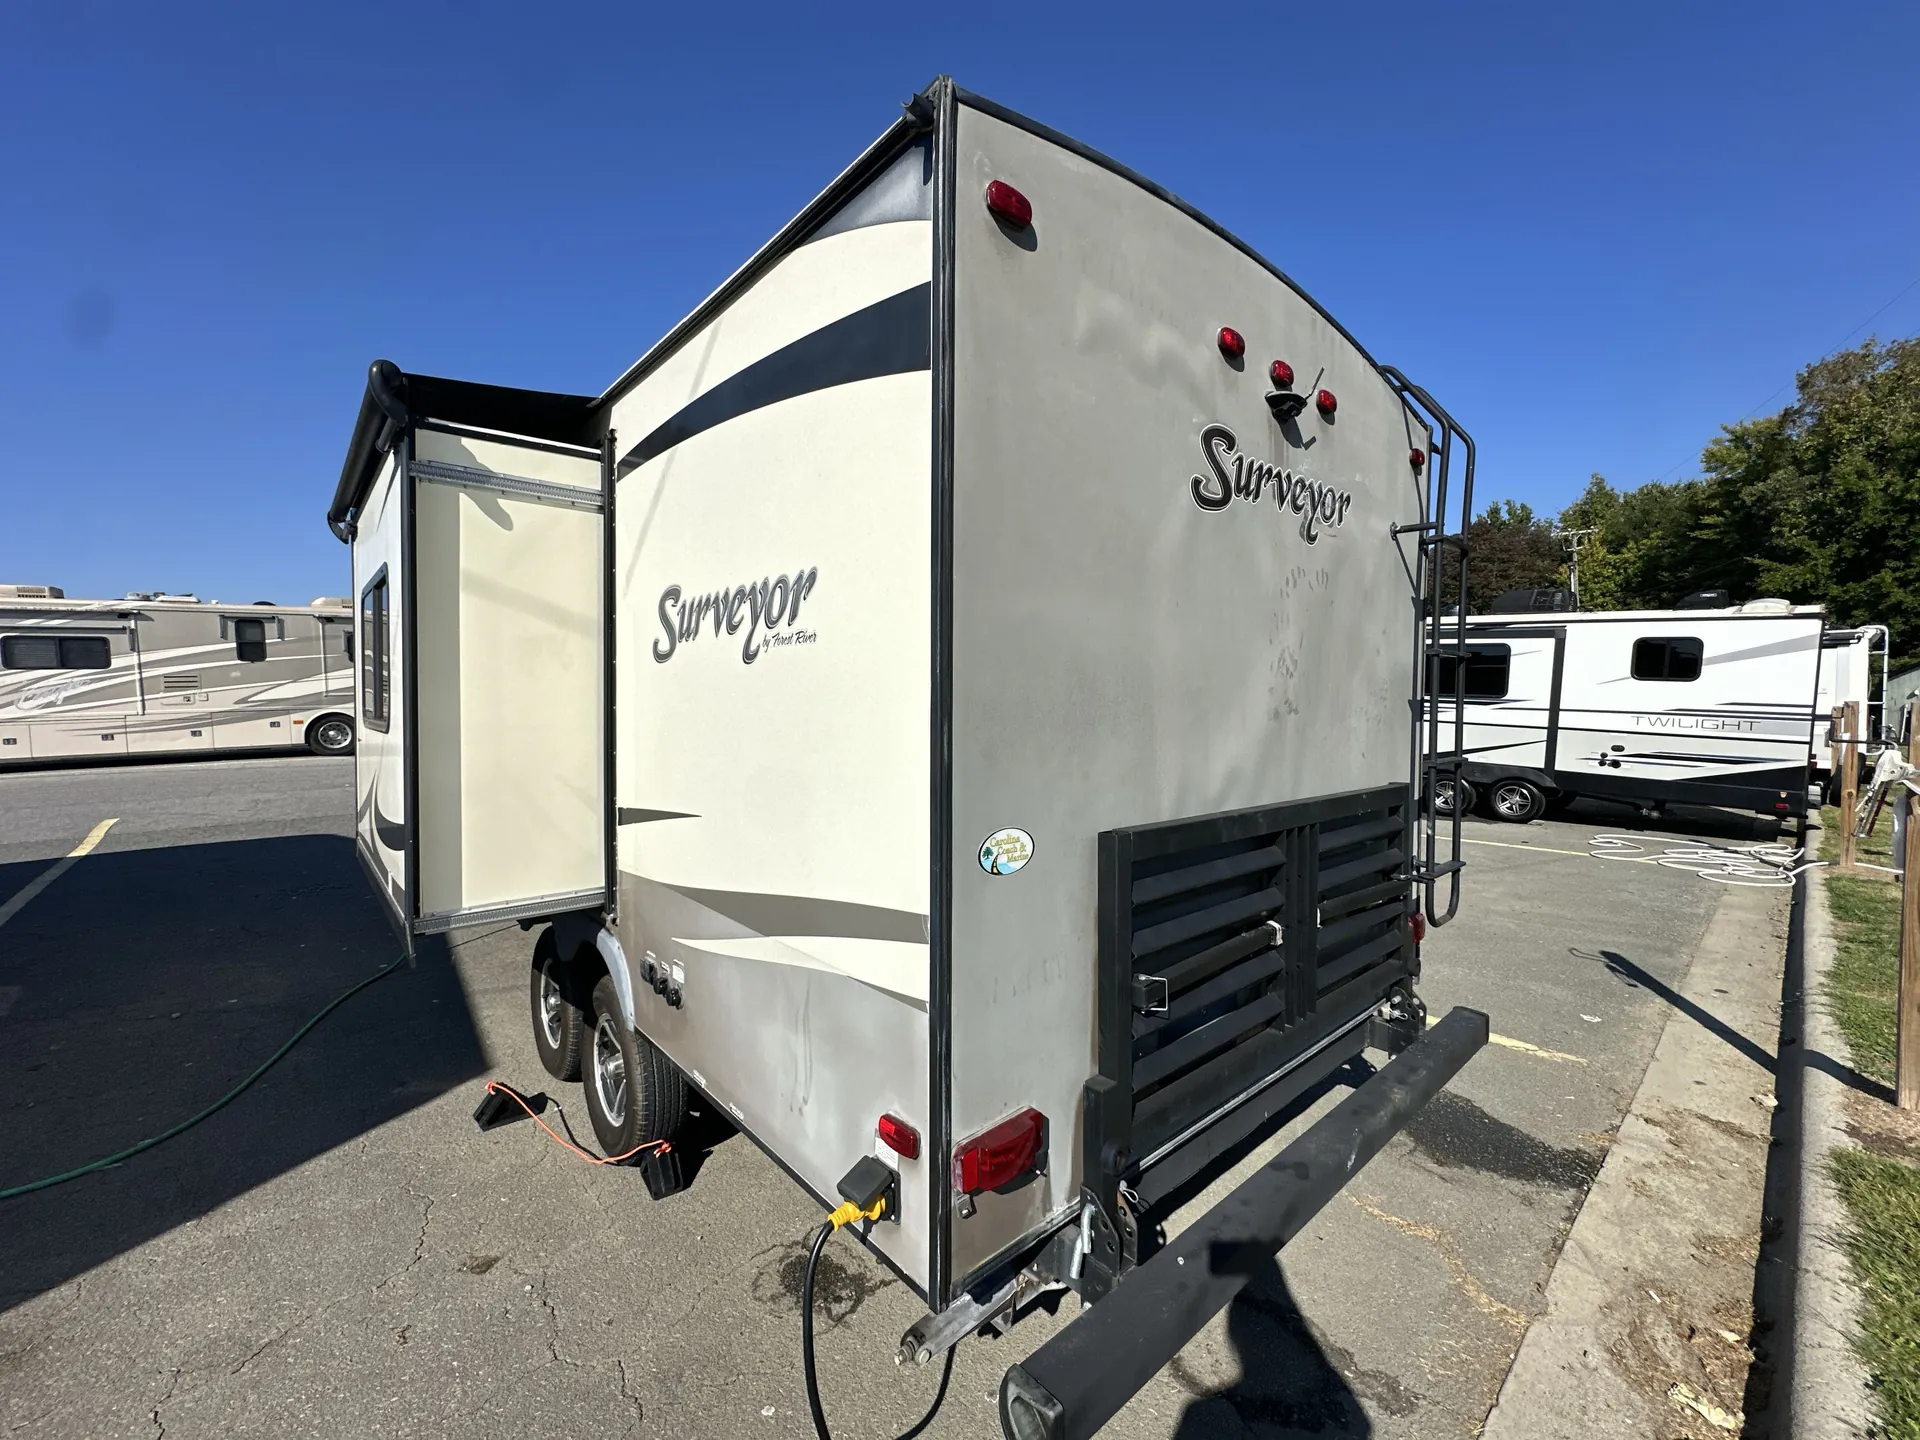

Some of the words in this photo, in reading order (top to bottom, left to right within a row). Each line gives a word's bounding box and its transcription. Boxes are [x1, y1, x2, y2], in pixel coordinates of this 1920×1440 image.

[1190, 423, 1351, 546] Surveyor
[653, 566, 818, 665] Surveyor
[762, 632, 772, 653] by
[772, 632, 794, 648] Forest
[795, 630, 817, 645] River
[1631, 716, 1761, 732] TWILIGHT
[1019, 842, 1027, 853] &
